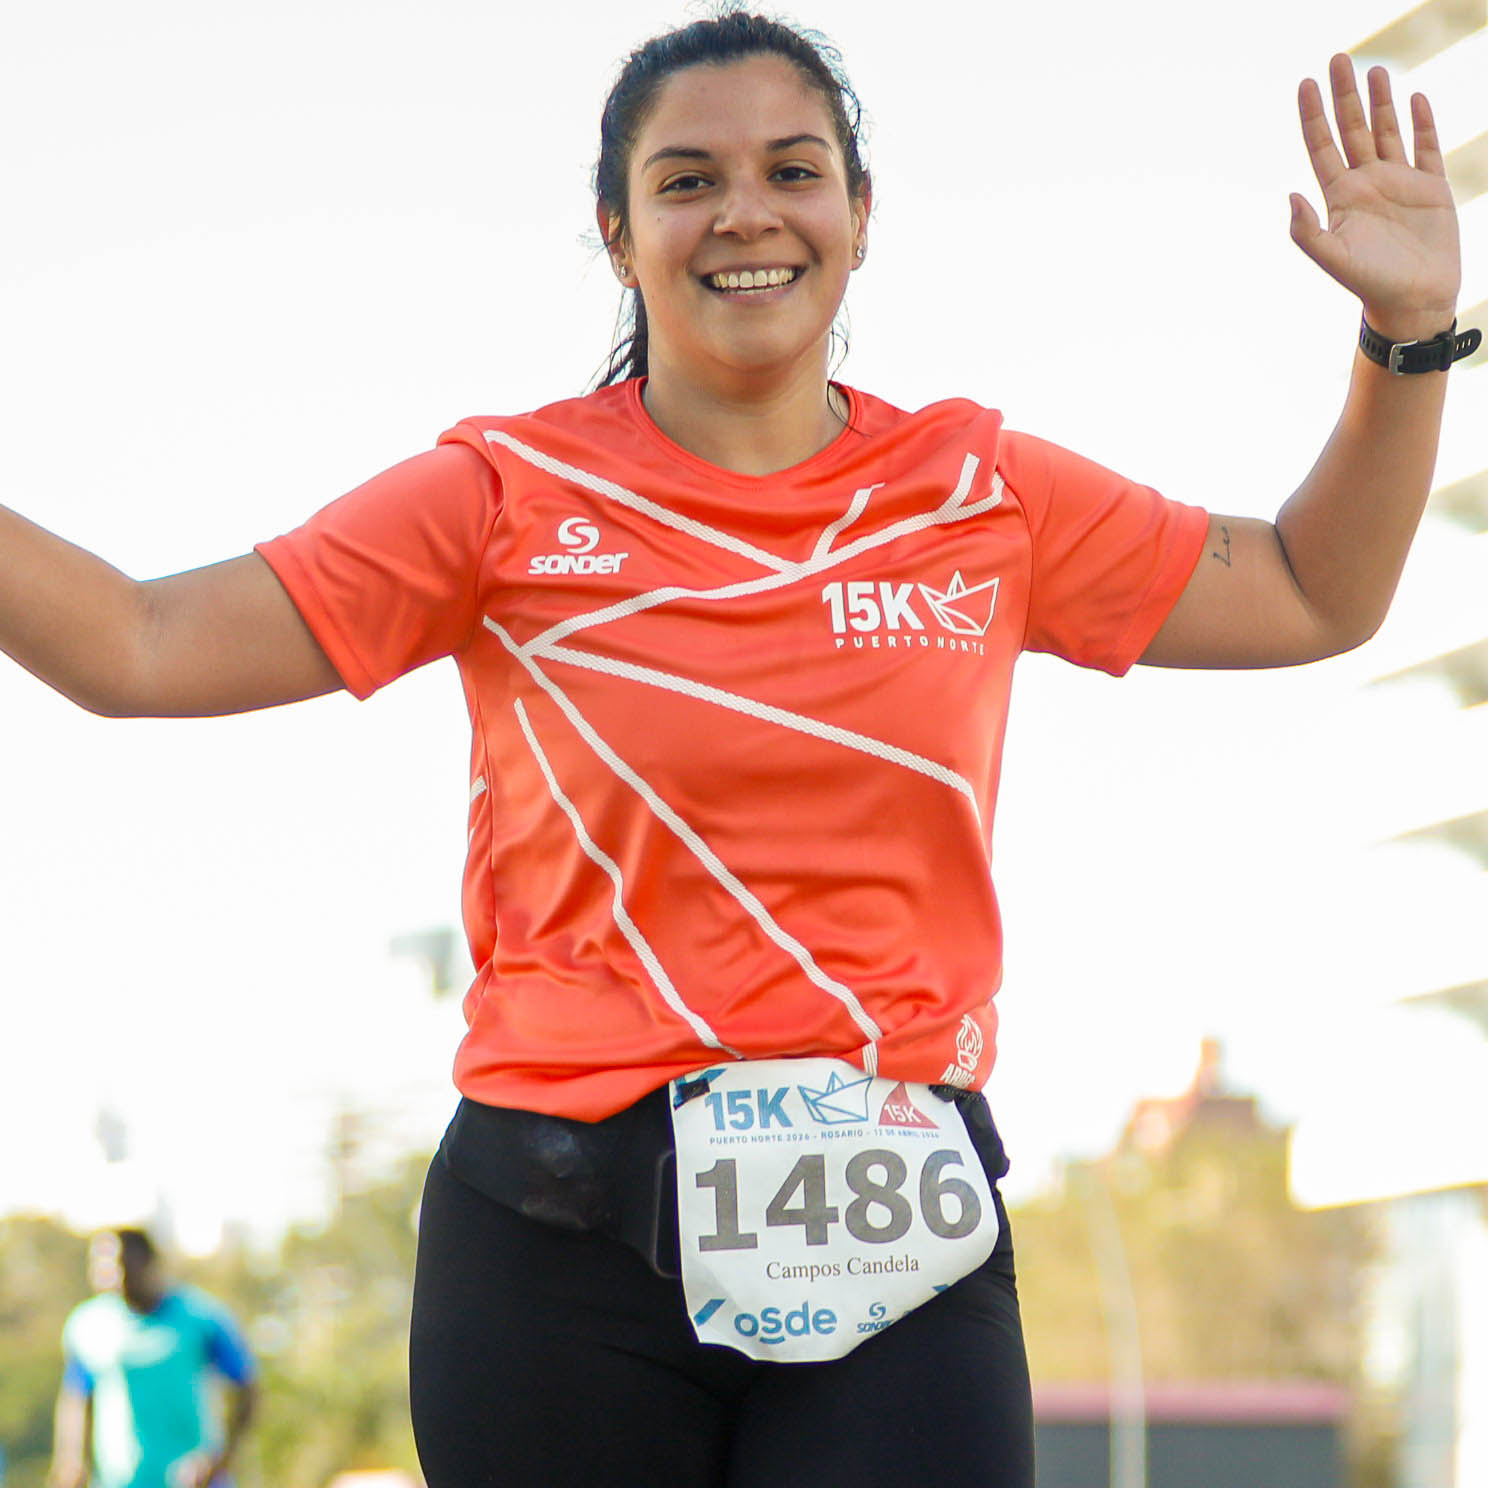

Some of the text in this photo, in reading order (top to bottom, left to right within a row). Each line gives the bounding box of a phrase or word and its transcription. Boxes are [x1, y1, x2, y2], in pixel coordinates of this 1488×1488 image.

[822, 581, 925, 633] 15K
[835, 635, 985, 656] PUERTO NORTE
[704, 1086, 794, 1131] 15K
[883, 1102, 923, 1124] 15K
[709, 1135, 748, 1145] PUERTO
[751, 1135, 784, 1144] NORTE
[820, 1129, 864, 1139] ROSARIO
[695, 1149, 982, 1252] 1486
[765, 1254, 920, 1282] Campos Candela
[734, 1300, 838, 1338] osde
